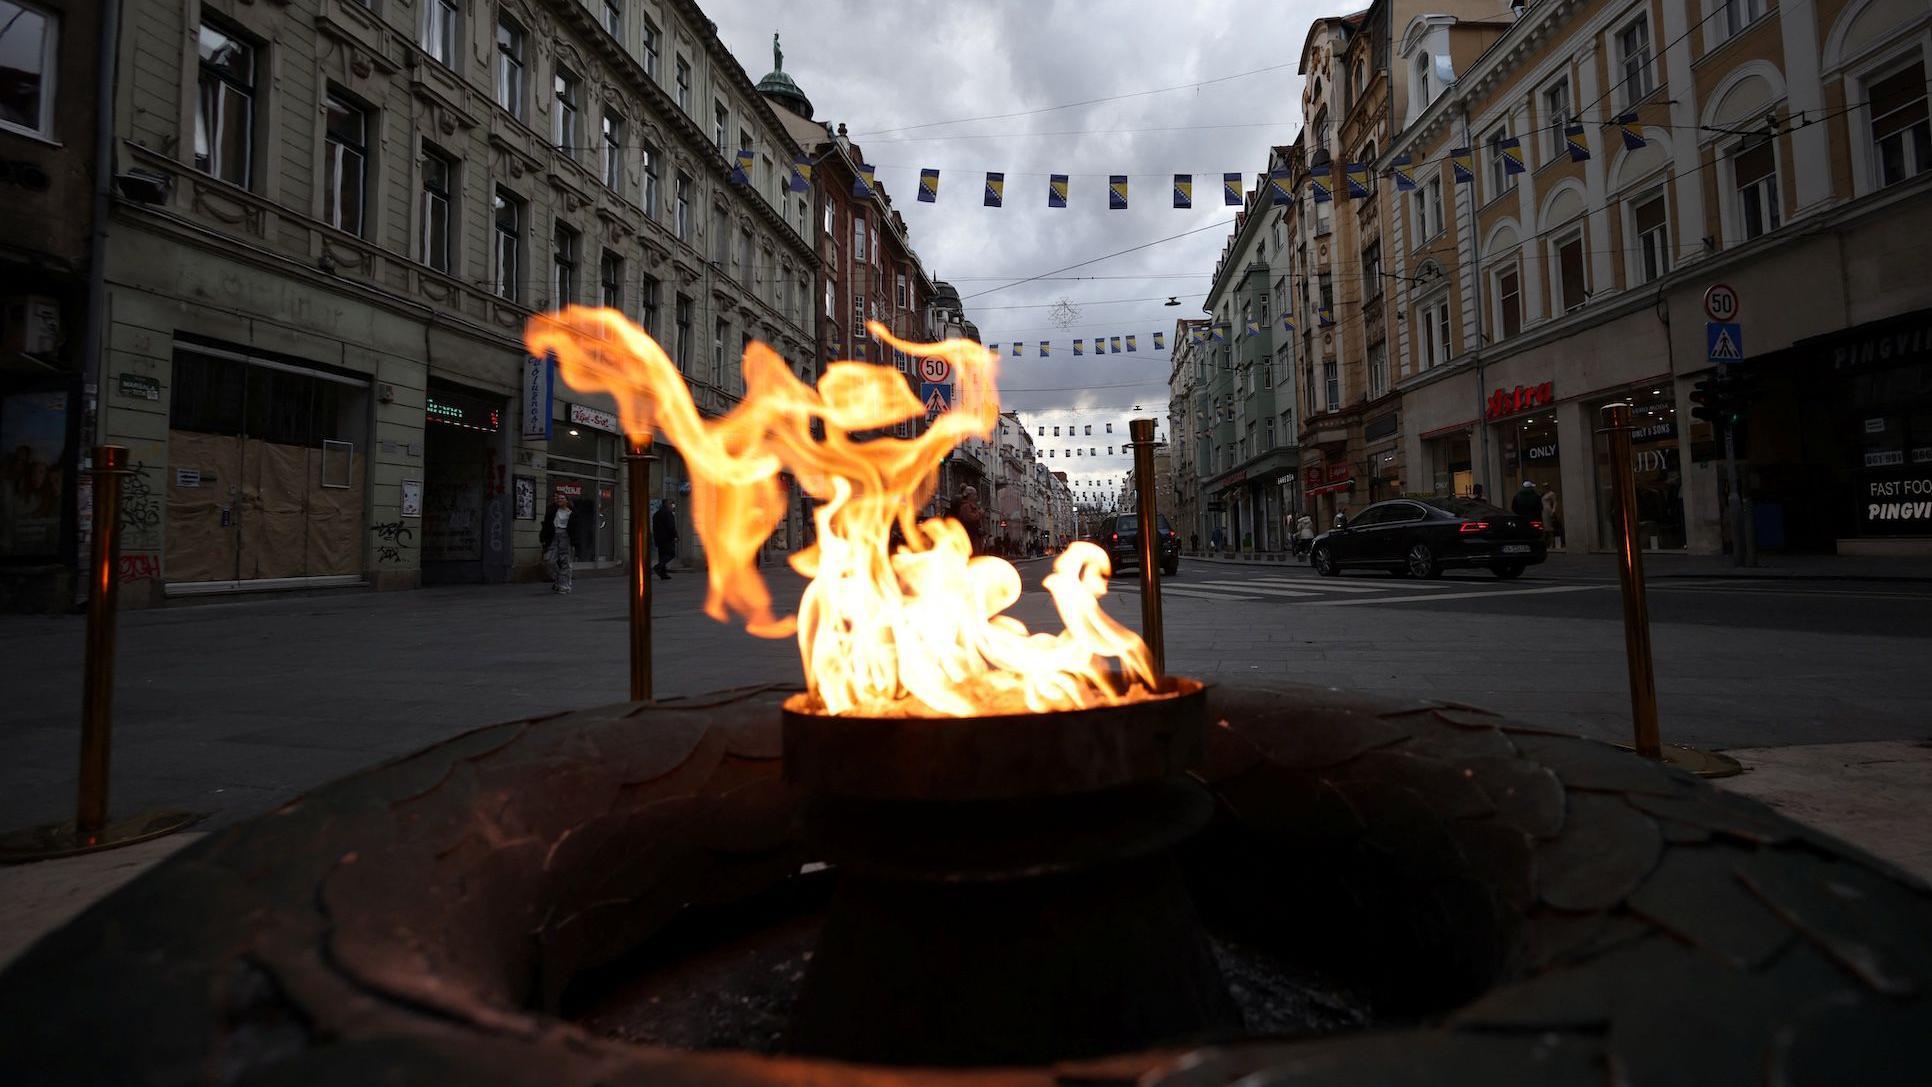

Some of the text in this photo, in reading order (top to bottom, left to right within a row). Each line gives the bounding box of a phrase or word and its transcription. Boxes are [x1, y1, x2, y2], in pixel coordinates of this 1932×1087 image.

[1712, 294, 1732, 313] 50
[926, 360, 944, 376] 50
[1487, 380, 1553, 418] Astra
[1653, 424, 1671, 436] SONS
[1529, 444, 1557, 460] ONLY
[1633, 448, 1670, 473] JDY
[1870, 479, 1932, 497] FAST FOO
[1868, 501, 1932, 521] PINGVI
